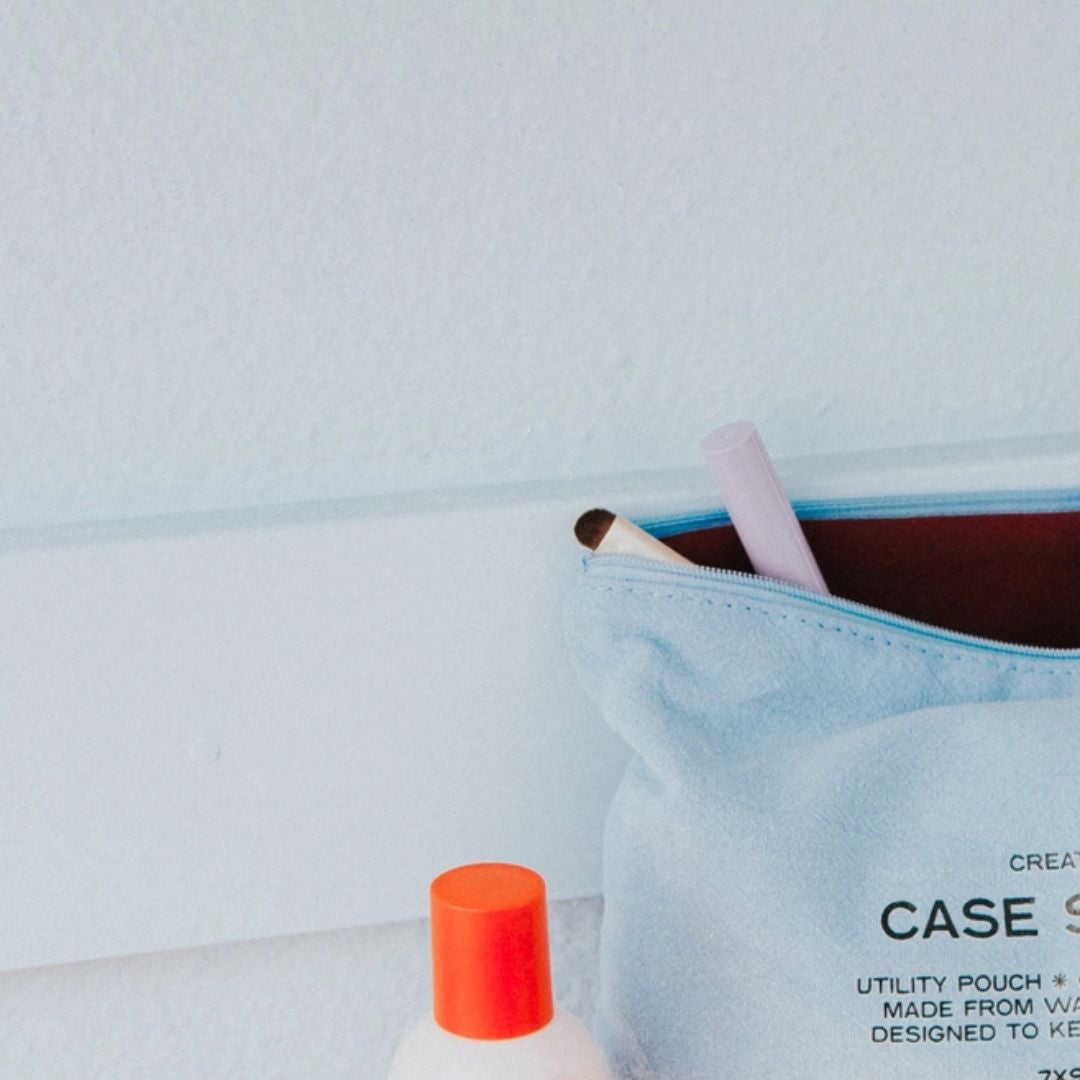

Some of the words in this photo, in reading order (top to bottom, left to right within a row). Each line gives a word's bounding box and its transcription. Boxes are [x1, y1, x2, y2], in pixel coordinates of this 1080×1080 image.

[880, 896, 1039, 941] CASE
[857, 976, 947, 995] UTILITY
[958, 973, 1041, 992] POUCH
[883, 1001, 954, 1019] MADE
[964, 998, 1033, 1016] FROM
[871, 1024, 996, 1043] DESIGNED
[1006, 1022, 1039, 1040] TO
